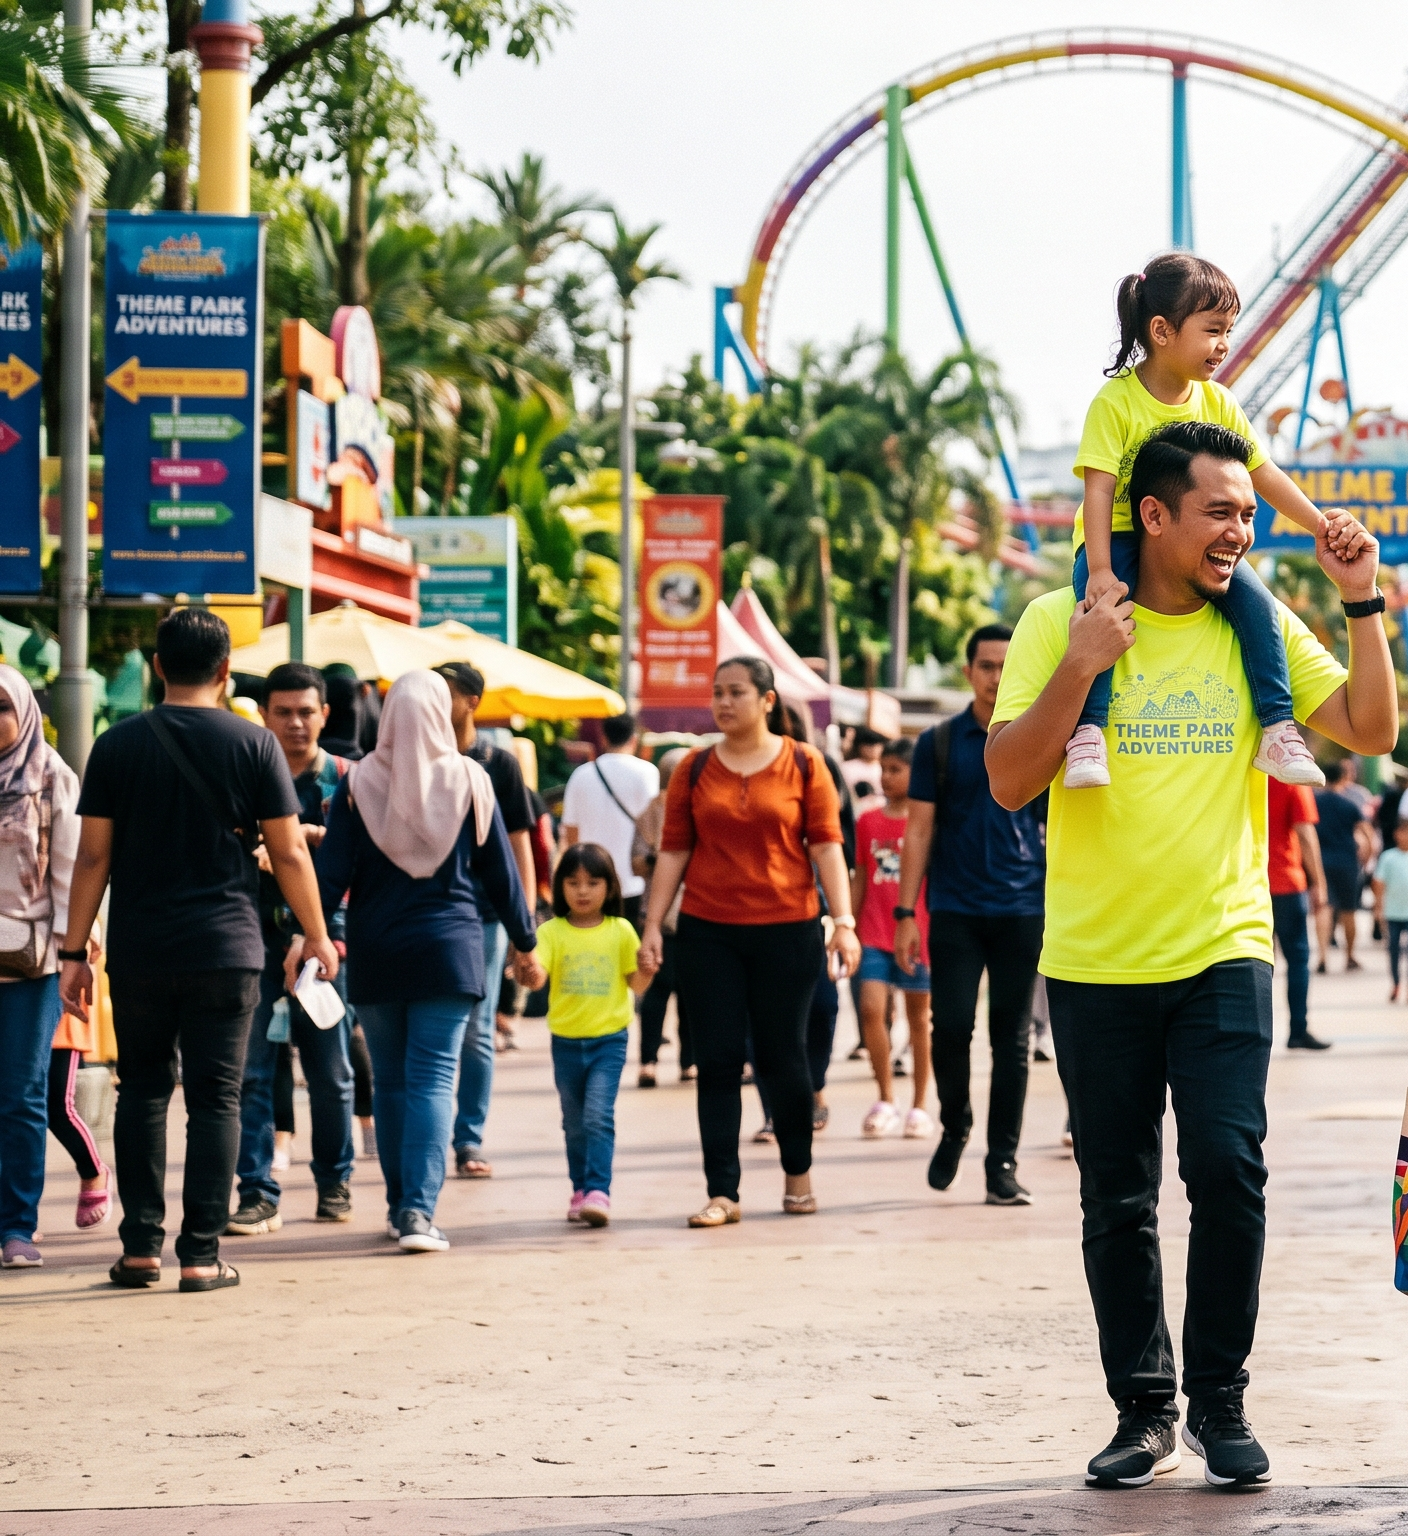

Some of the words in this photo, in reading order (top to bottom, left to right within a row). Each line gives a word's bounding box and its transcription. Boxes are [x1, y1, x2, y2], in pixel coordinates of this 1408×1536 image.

[0, 291, 29, 311] RK
[116, 294, 187, 315] THEME
[190, 296, 247, 316] PARK
[114, 315, 248, 337] ADVENTURES
[1286, 469, 1396, 503] HEME
[1114, 723, 1181, 738] THEME
[1186, 722, 1236, 738] PARK
[1116, 740, 1234, 755] ADVENTURES
